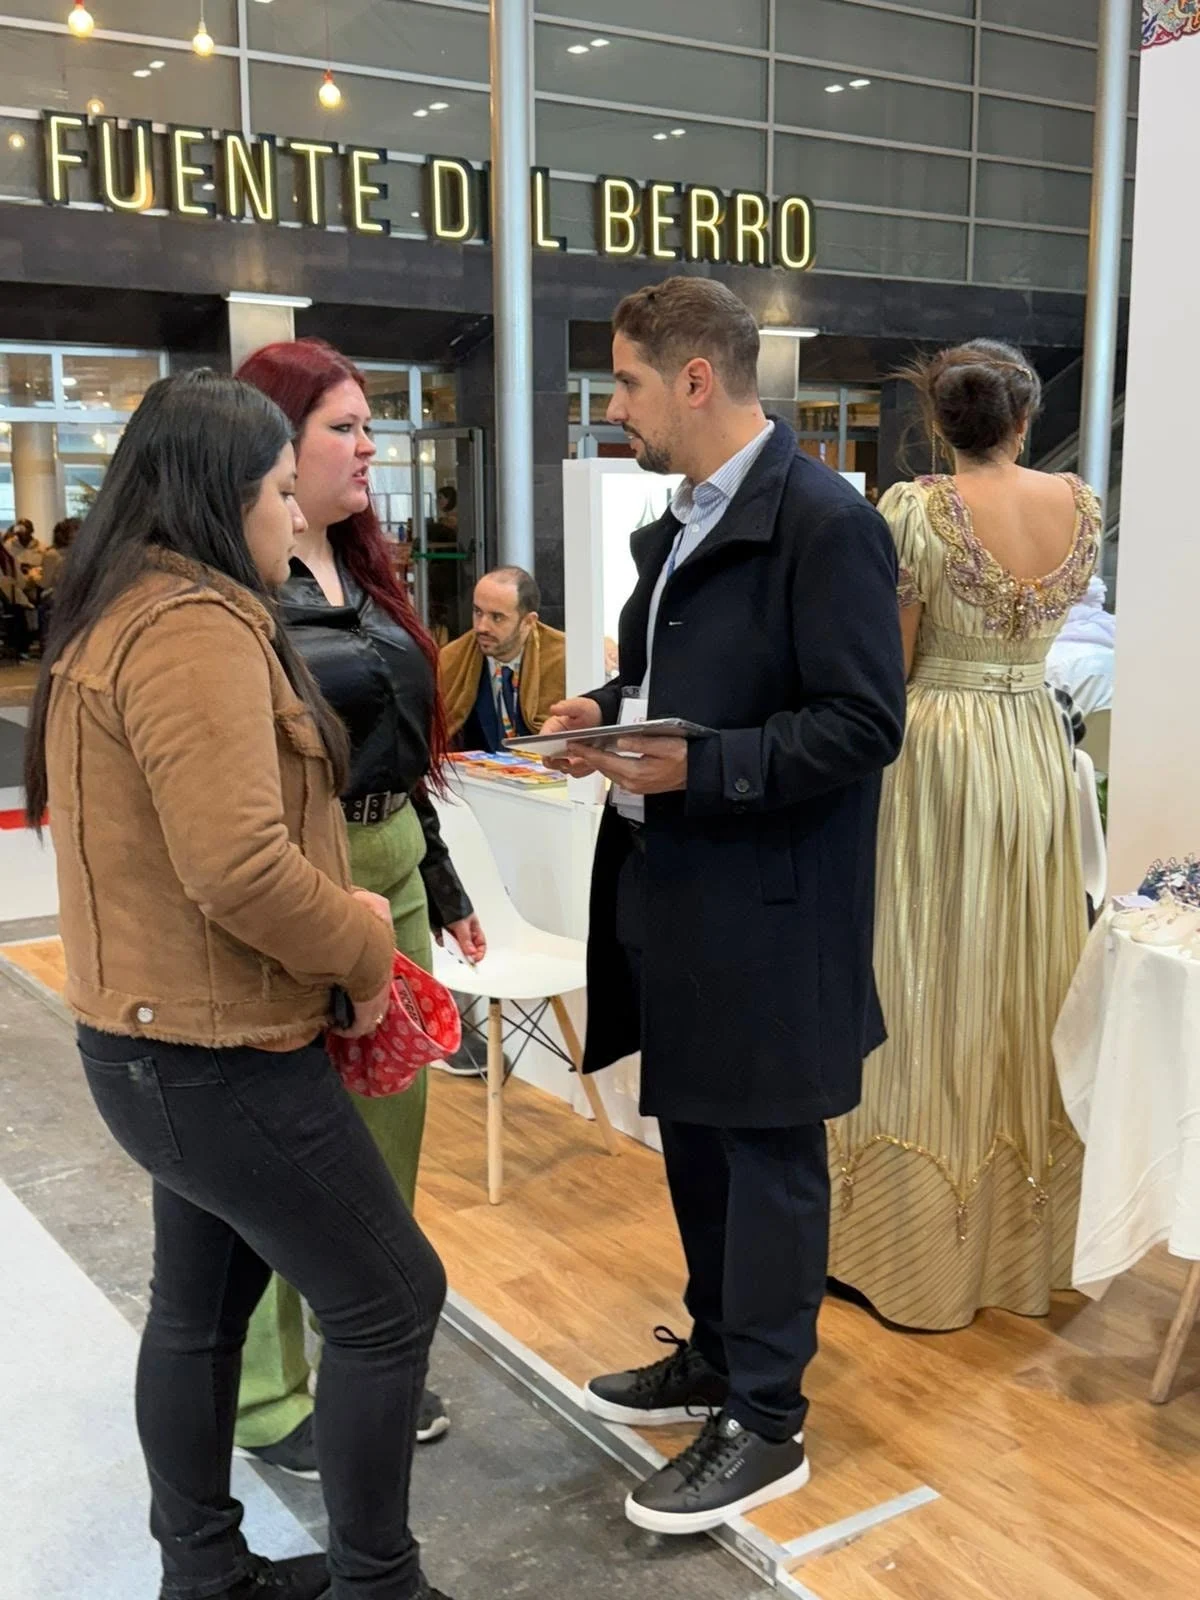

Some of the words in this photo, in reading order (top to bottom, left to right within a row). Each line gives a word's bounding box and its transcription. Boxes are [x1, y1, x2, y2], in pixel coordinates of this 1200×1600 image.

[45, 112, 389, 234] FUENTE
[429, 156, 565, 250] DL
[600, 176, 815, 270] BERRO
